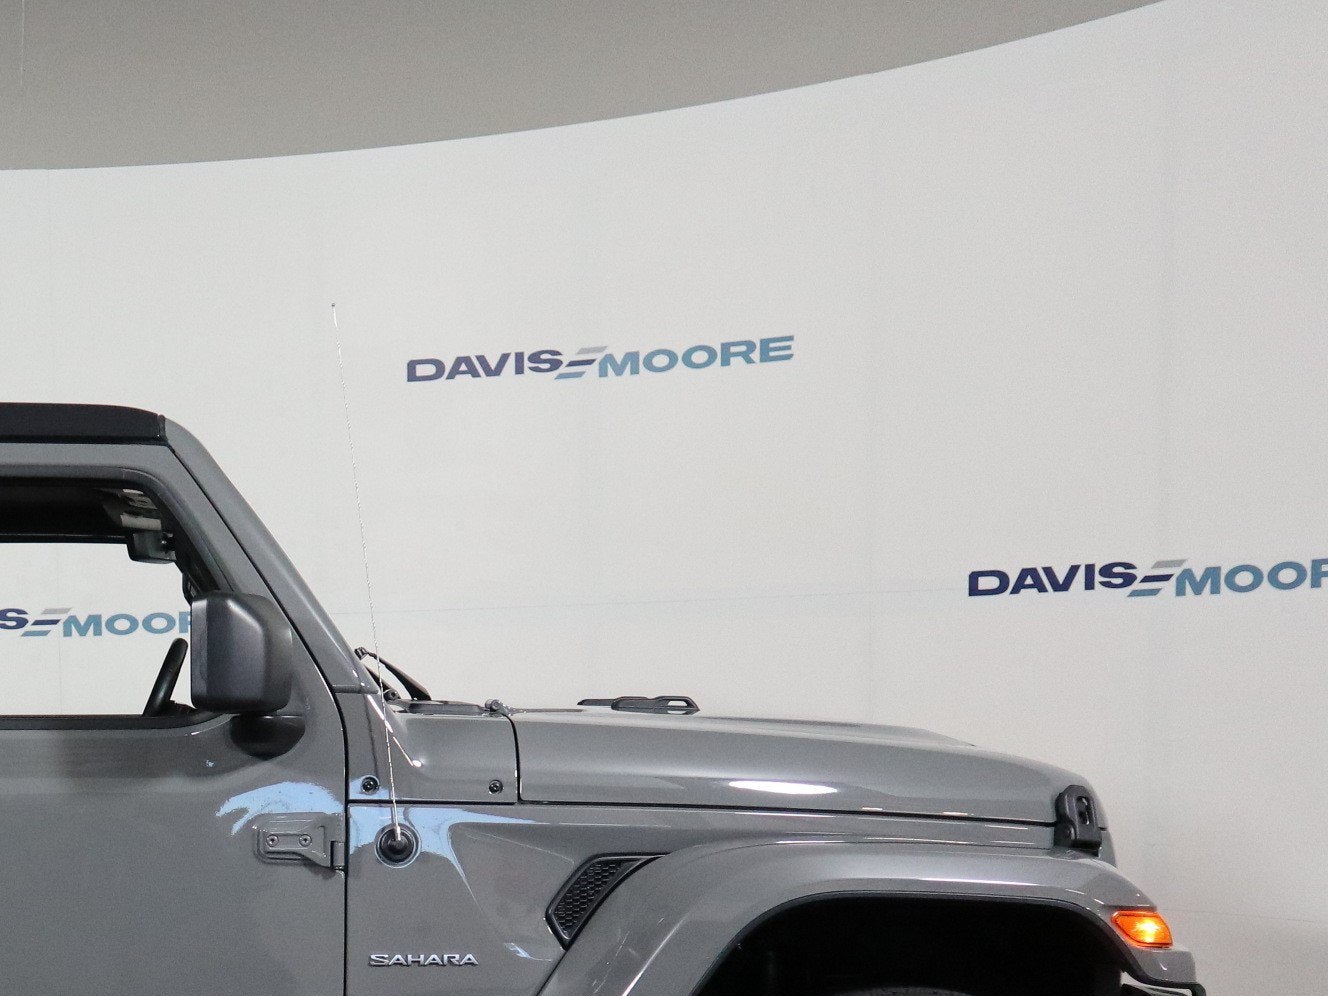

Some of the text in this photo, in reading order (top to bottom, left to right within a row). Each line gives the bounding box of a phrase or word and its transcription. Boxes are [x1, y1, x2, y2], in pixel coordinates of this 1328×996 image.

[406, 334, 795, 383] DAVIS MOORE
[968, 558, 1328, 597] DAVIS MOO
[62, 610, 191, 638] MOO
[369, 953, 479, 967] SAHARA
